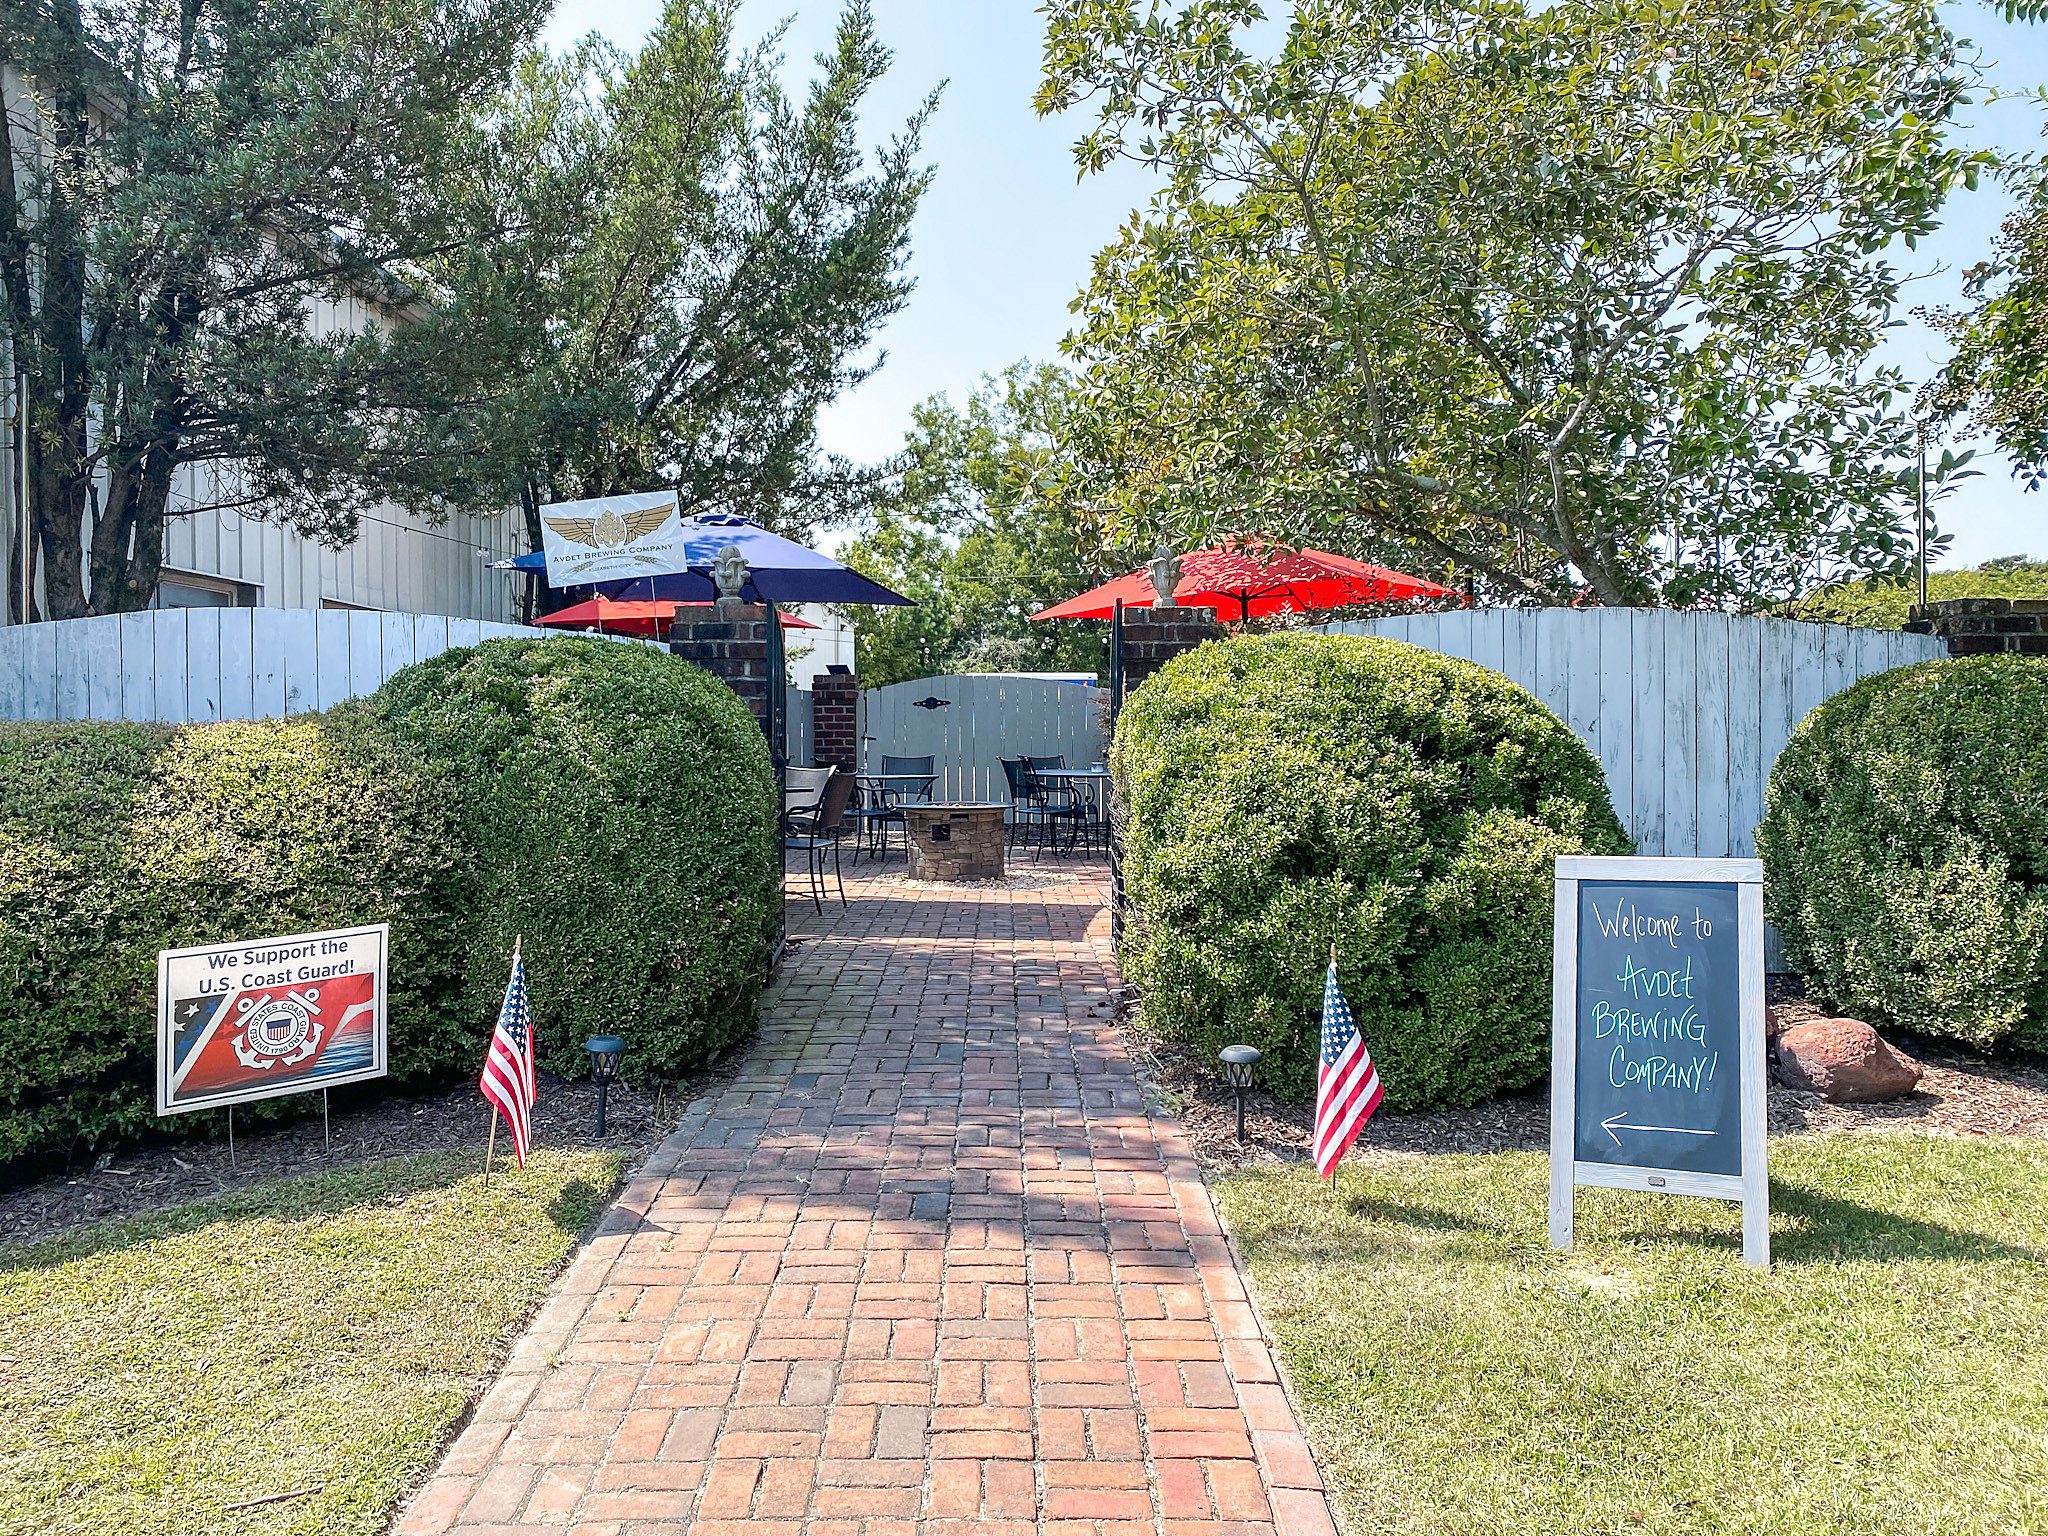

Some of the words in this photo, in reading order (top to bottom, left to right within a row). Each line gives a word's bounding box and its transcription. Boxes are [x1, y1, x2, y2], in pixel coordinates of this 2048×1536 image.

[553, 554, 581, 563] AVDET
[585, 549, 626, 559] BREWING
[628, 544, 673, 554] COMPANY
[1592, 897, 1683, 948] Welcome
[1691, 906, 1712, 940] to
[208, 954, 238, 970] We
[244, 943, 316, 966] Support
[321, 940, 348, 956] the
[199, 977, 236, 994] U.S.
[242, 969, 292, 989] Coast
[298, 959, 355, 981] Guard!
[251, 1004, 278, 1027] STATES
[281, 1002, 306, 1019] COAST
[250, 1028, 270, 1053] UNITED
[288, 1020, 307, 1048] GUARD
[271, 1046, 288, 1054] 1790
